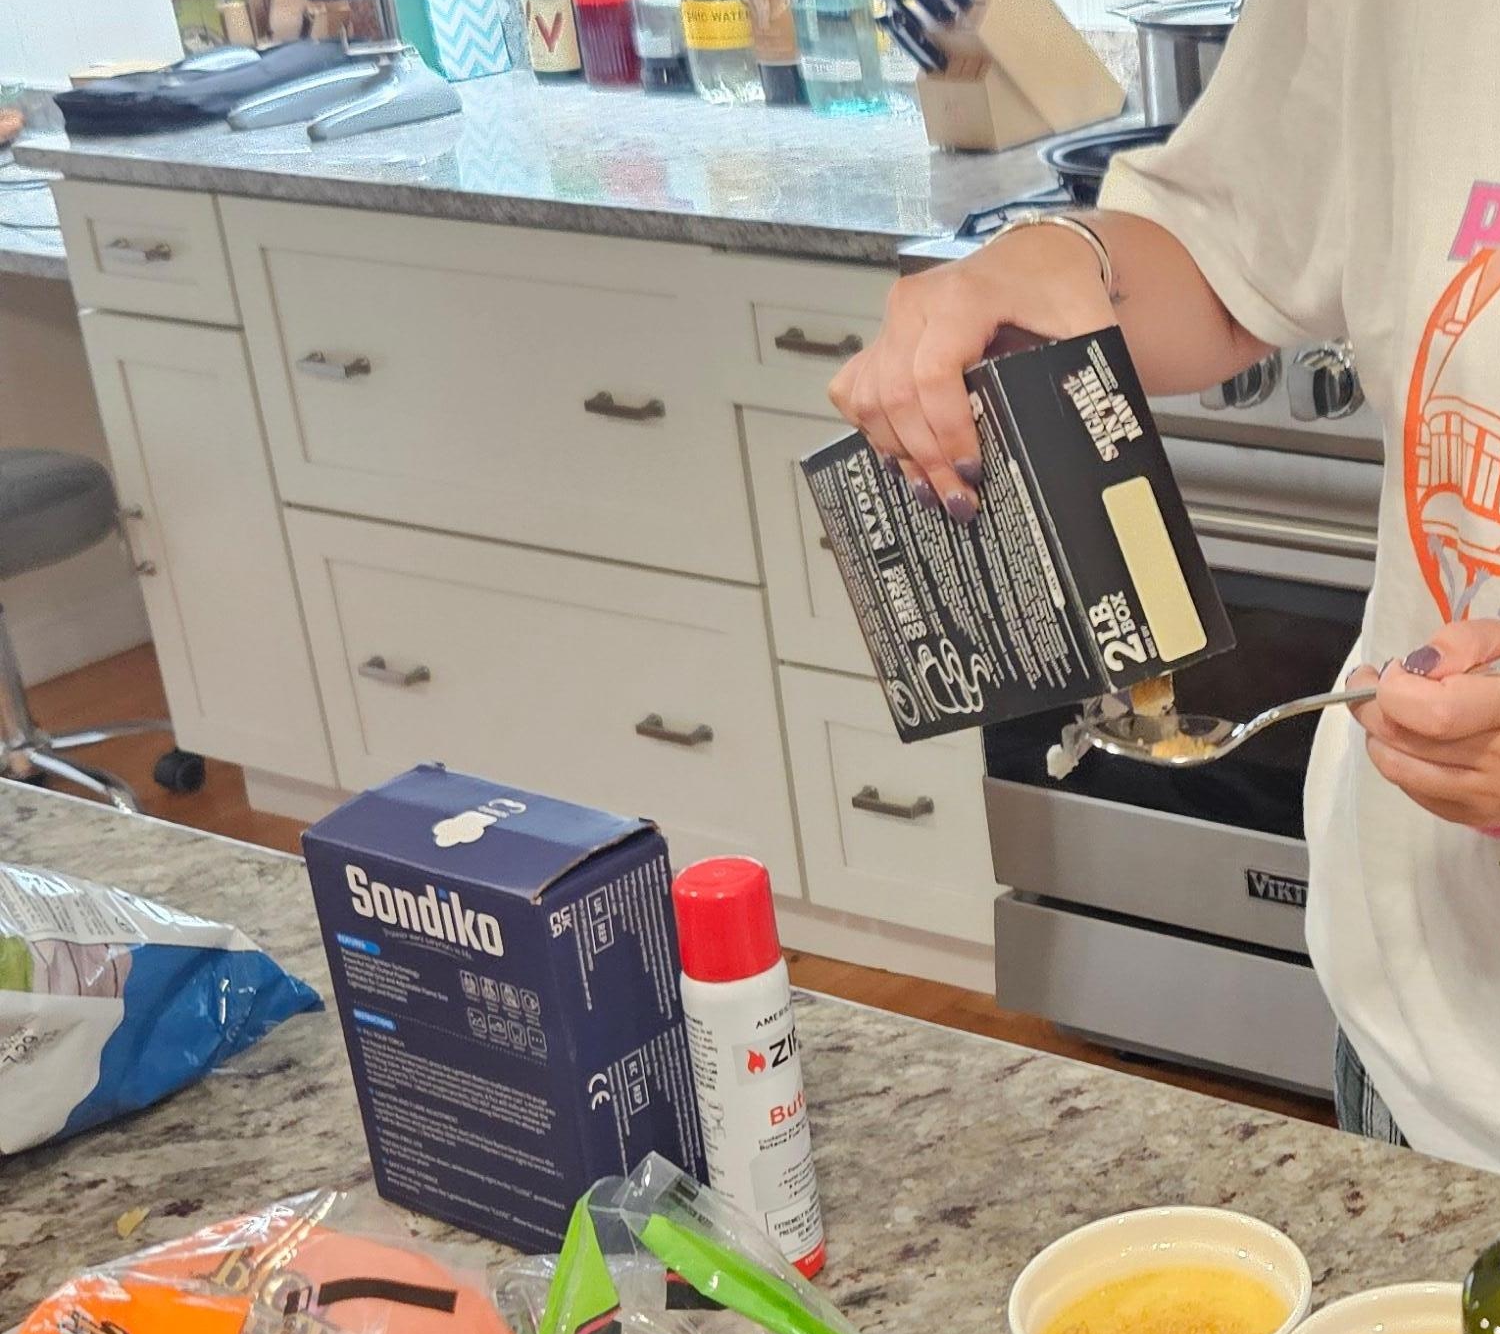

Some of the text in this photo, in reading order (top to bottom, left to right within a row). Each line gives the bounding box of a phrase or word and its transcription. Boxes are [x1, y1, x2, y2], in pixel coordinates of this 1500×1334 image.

[1069, 387, 1119, 463] SUGAR
[1077, 364, 1126, 442] IN THE
[1107, 393, 1143, 441] RAW
[843, 454, 886, 551] VEGAN
[881, 567, 911, 625] FREE
[1087, 594, 1148, 673] 2 LB.
[1108, 590, 1136, 634] BOX
[345, 864, 504, 957] Sondiko
[1250, 871, 1307, 904] VIKI
